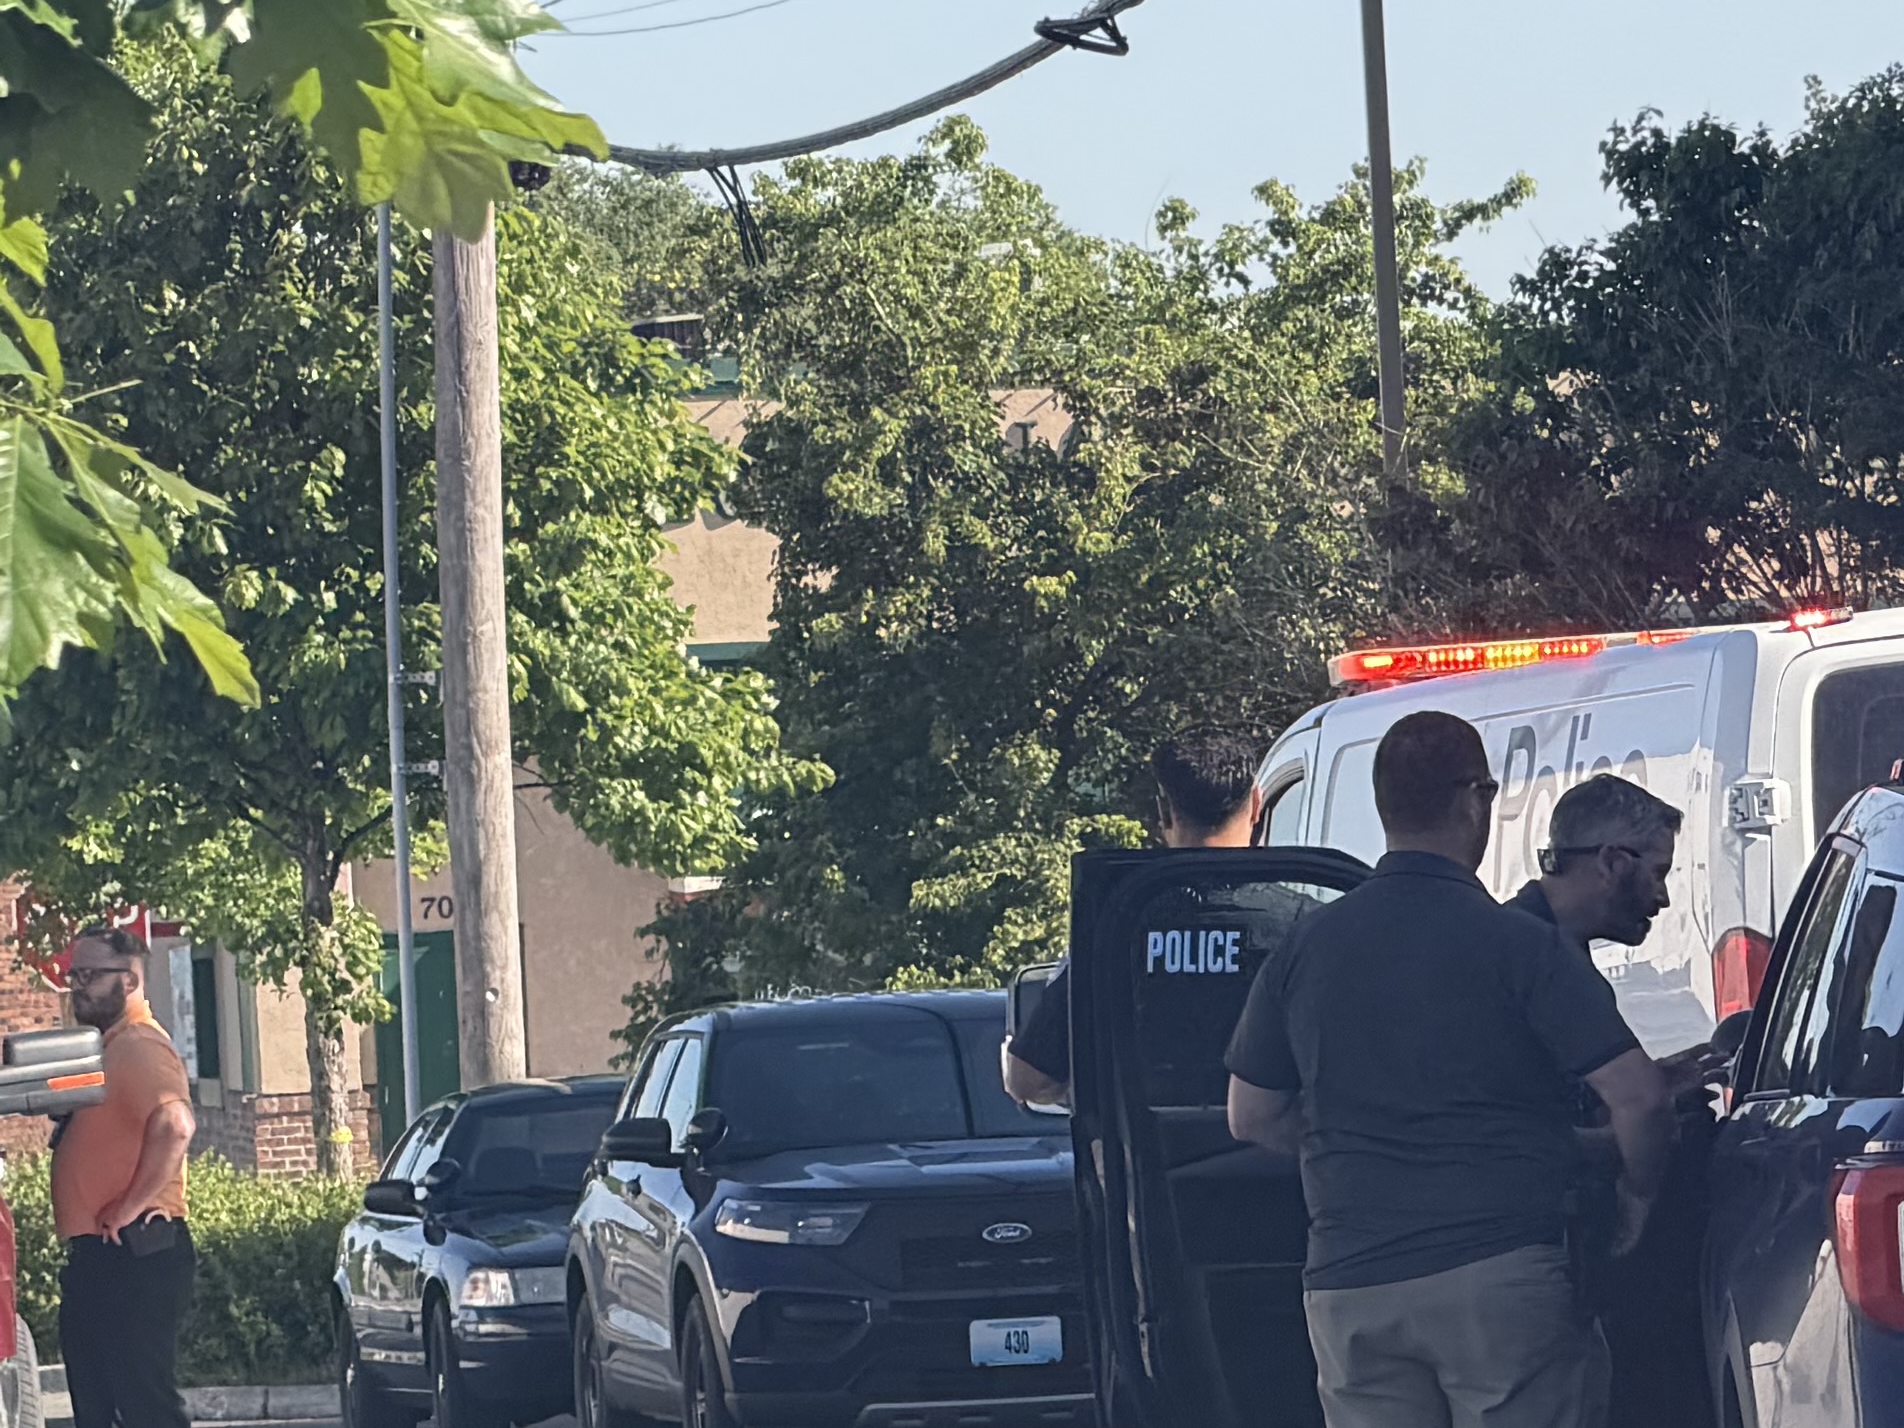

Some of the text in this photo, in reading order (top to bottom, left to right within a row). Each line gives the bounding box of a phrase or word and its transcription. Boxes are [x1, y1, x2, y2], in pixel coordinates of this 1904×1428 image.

[1493, 713, 1648, 893] Pol
[1146, 930, 1241, 974] POLICE
[1004, 1329, 1030, 1354] 430
